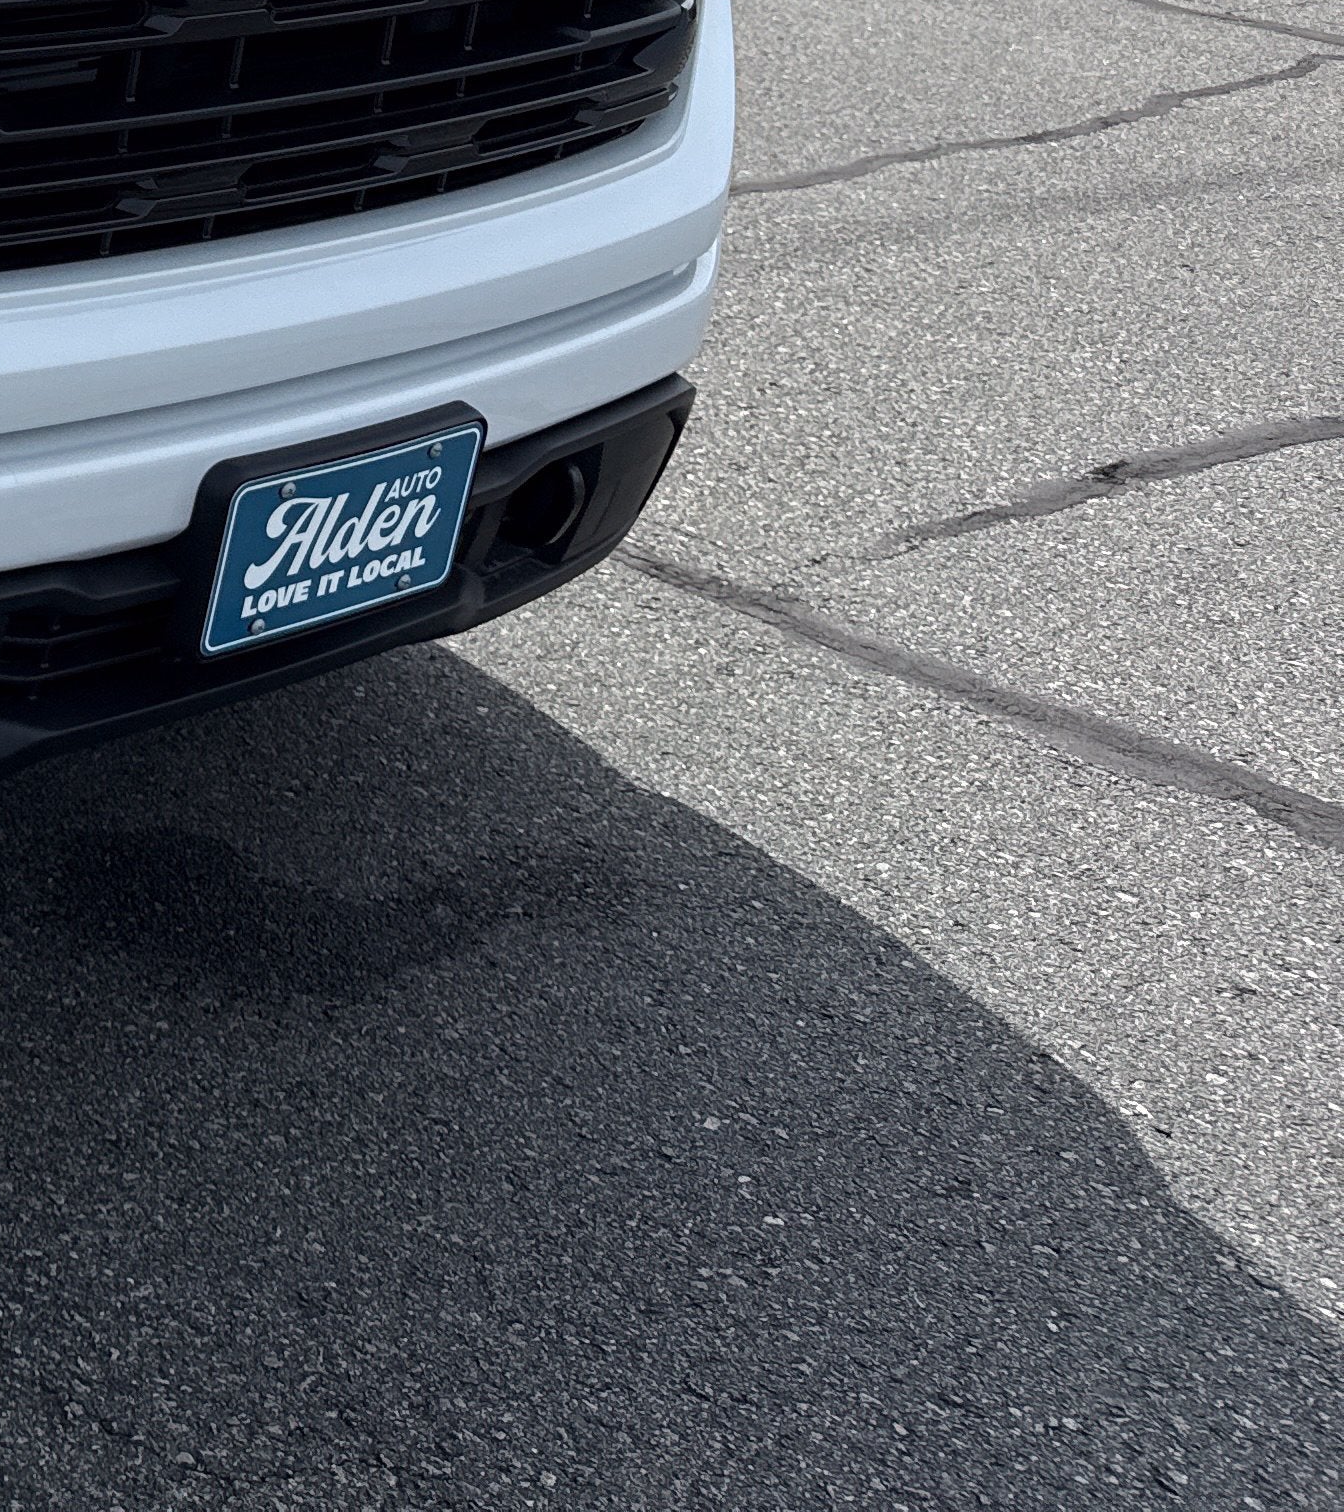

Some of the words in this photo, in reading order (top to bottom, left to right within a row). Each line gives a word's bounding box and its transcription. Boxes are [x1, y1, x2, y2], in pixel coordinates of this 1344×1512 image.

[384, 465, 442, 503] AUTO
[243, 481, 441, 590] Alden
[240, 580, 310, 618] LOVE
[316, 570, 344, 597] IT
[346, 545, 427, 588] LOCAL
